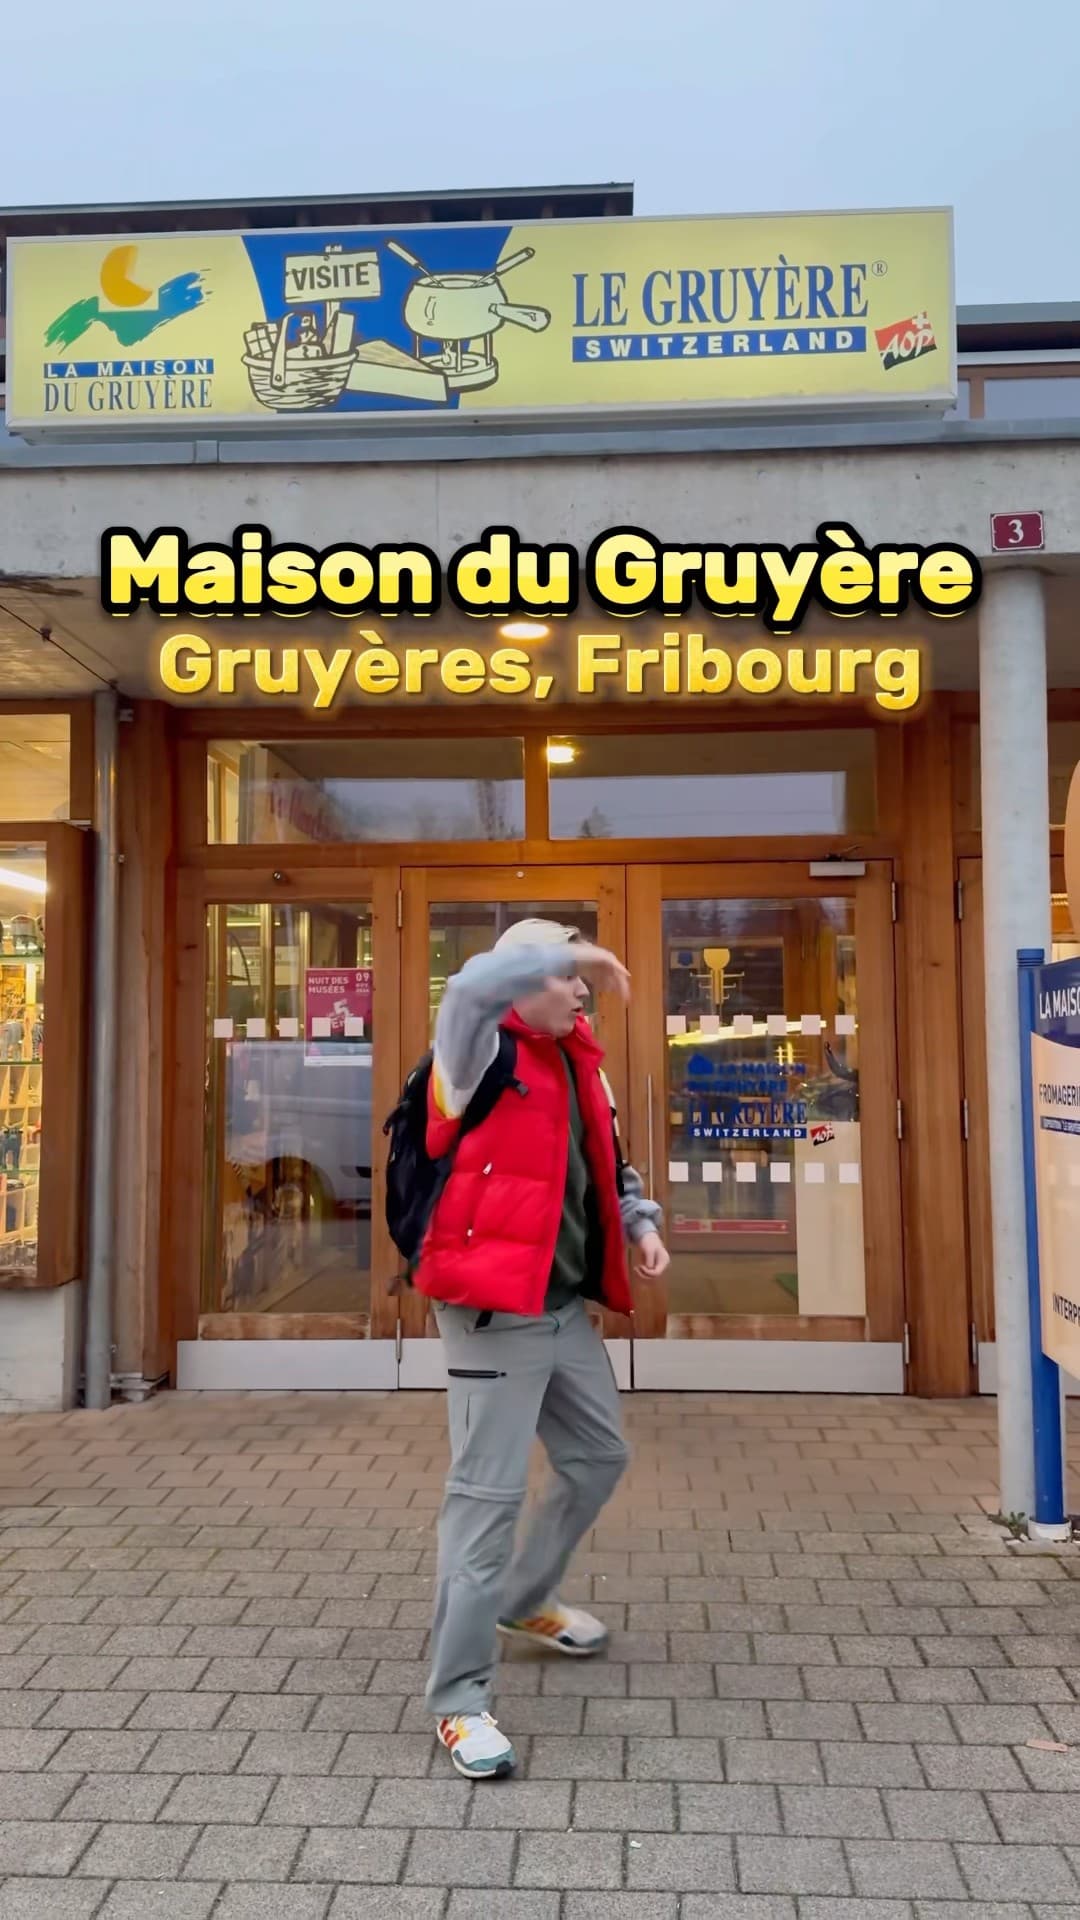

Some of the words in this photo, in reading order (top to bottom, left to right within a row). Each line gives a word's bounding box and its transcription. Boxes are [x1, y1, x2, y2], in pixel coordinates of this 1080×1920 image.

[291, 262, 370, 291] VISITE
[572, 271, 629, 327] LE
[585, 330, 854, 359] SWITZERLAND
[880, 328, 934, 362] AOP
[46, 363, 79, 379] LA
[97, 359, 209, 377] MAISON
[44, 381, 78, 412] DU
[88, 375, 213, 411] GRUYÈRE
[1008, 519, 1024, 544] 3
[308, 976, 329, 985] NUIT
[331, 976, 349, 985] DES
[308, 985, 345, 993] MUSÉES
[1039, 991, 1052, 1020] LA
[1039, 1083, 1080, 1107] FROMAGERI
[693, 1127, 802, 1137] SWITZERLAND
